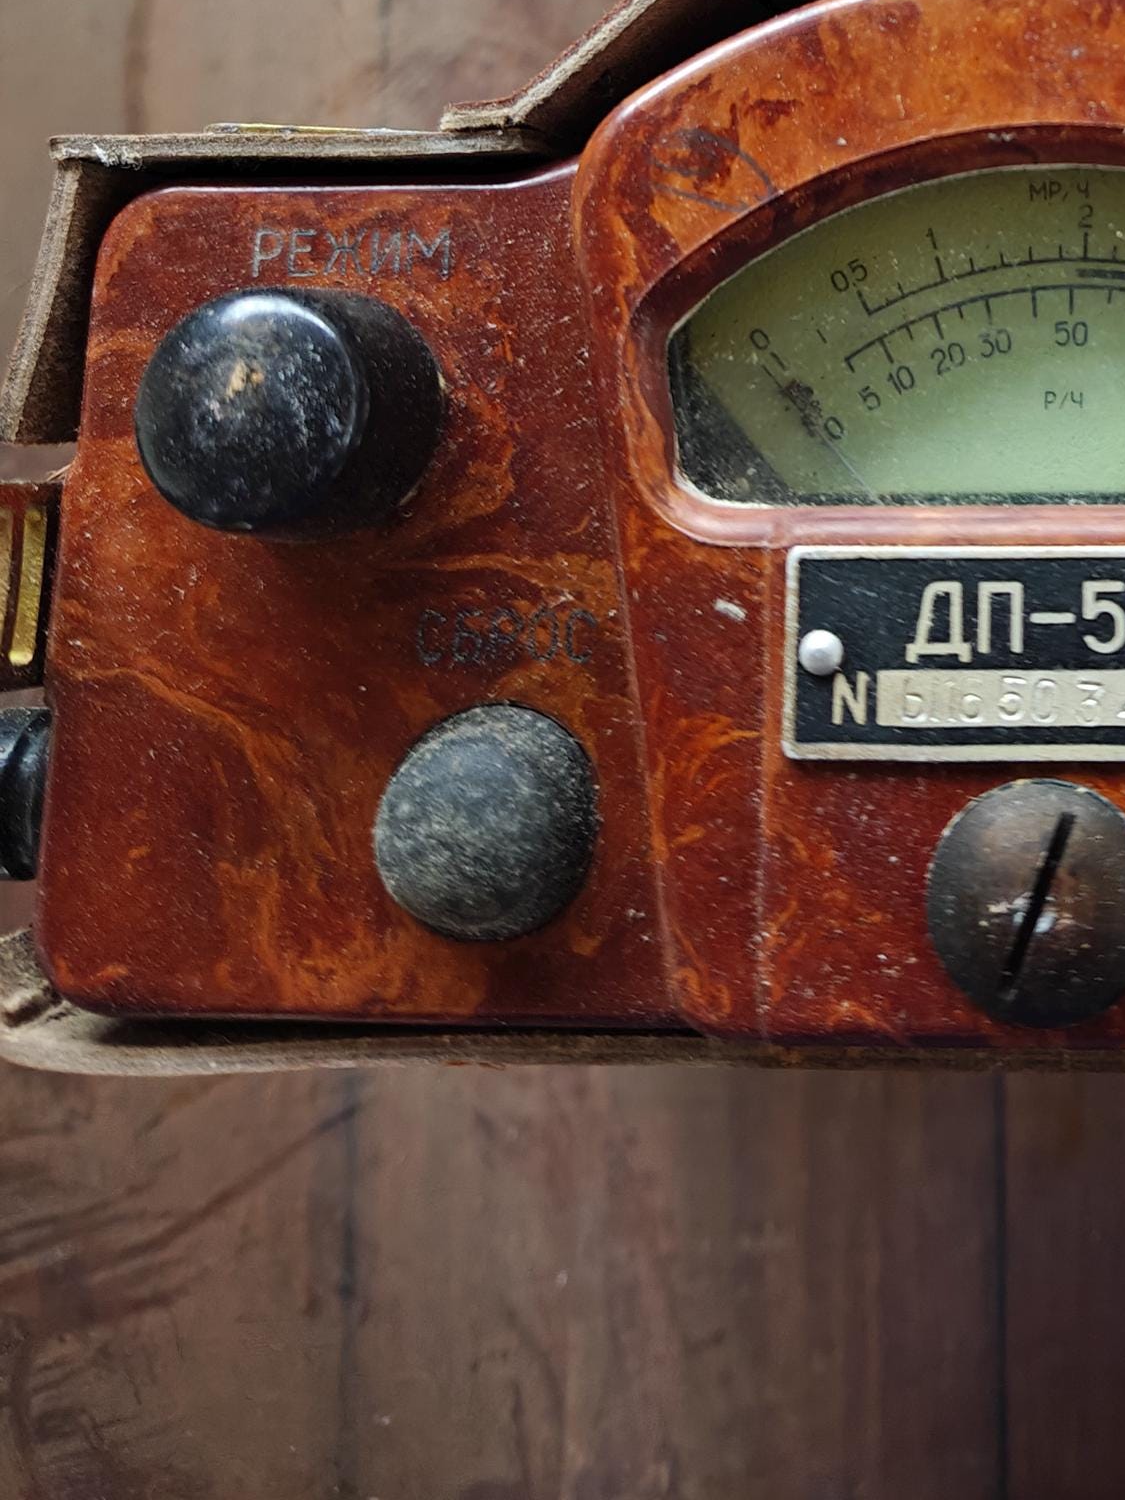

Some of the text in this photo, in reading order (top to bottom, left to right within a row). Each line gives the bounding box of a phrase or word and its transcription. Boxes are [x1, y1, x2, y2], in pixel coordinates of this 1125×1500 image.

[1077, 204, 1093, 228] 2
[925, 227, 939, 251] 1
[250, 227, 456, 281] РЕЖИМ
[749, 328, 770, 350] 0
[978, 328, 1012, 359] 30
[1054, 321, 1089, 348] 50
[930, 342, 966, 376] 20
[887, 365, 916, 395] 10
[857, 385, 882, 411] 5
[1044, 390, 1084, 410] Р/Ч
[823, 416, 845, 441] 0
[413, 605, 599, 667] СБРОС
